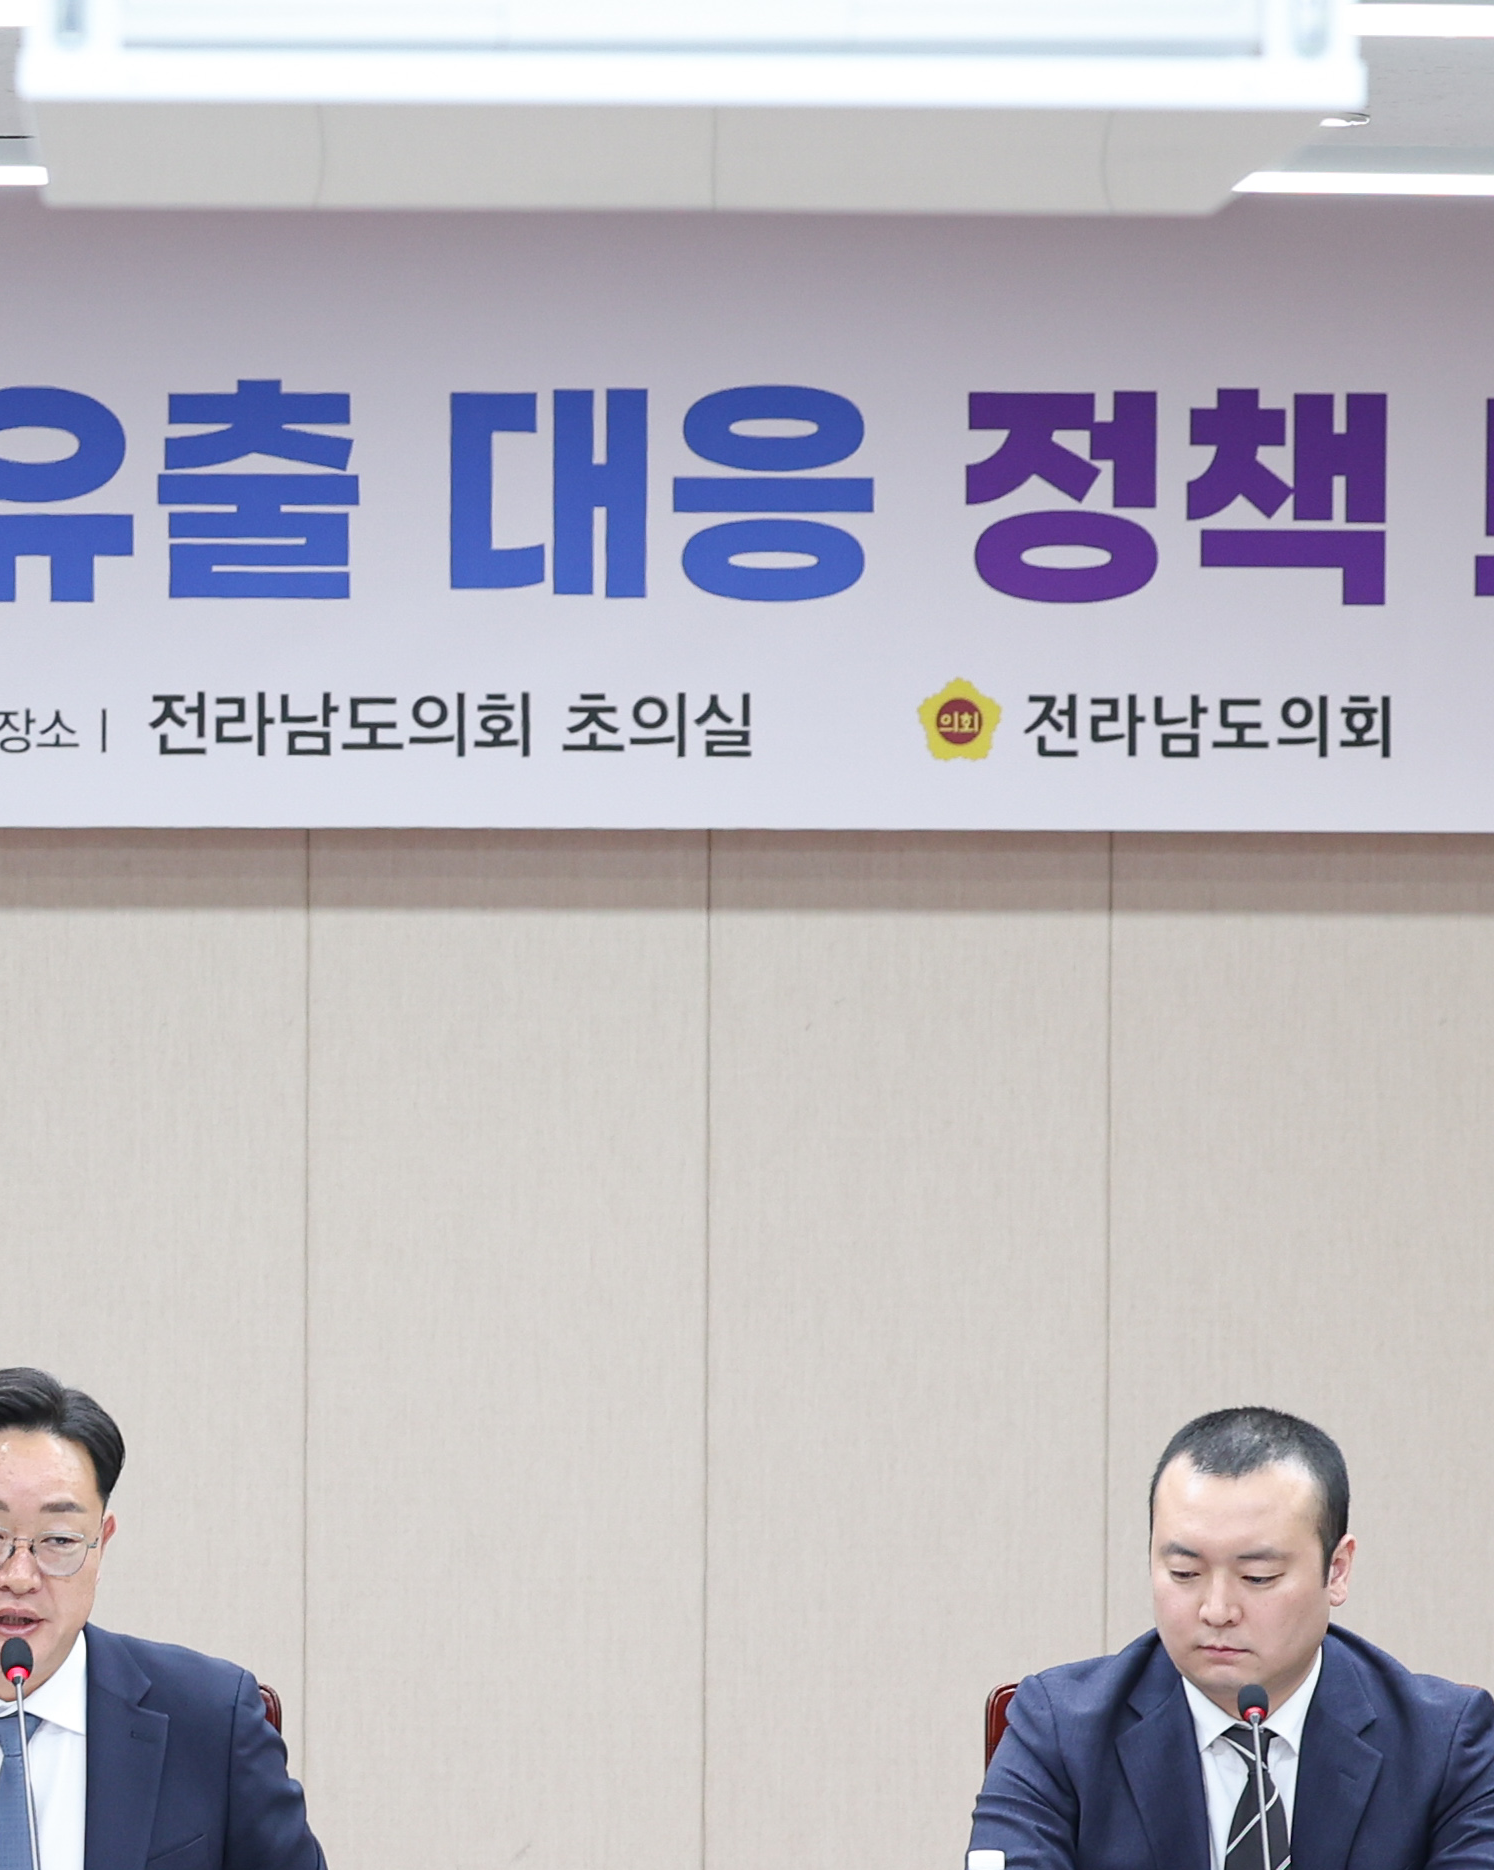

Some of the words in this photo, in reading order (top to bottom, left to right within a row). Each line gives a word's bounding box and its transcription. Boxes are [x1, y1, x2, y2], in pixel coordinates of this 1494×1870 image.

[450, 385, 874, 602] 대응
[965, 388, 1388, 605] 정책
[149, 692, 530, 757] 전라남도의회
[563, 693, 751, 757] 초의실
[939, 711, 979, 733] 의회
[1024, 694, 1390, 758] 전라남도의회
